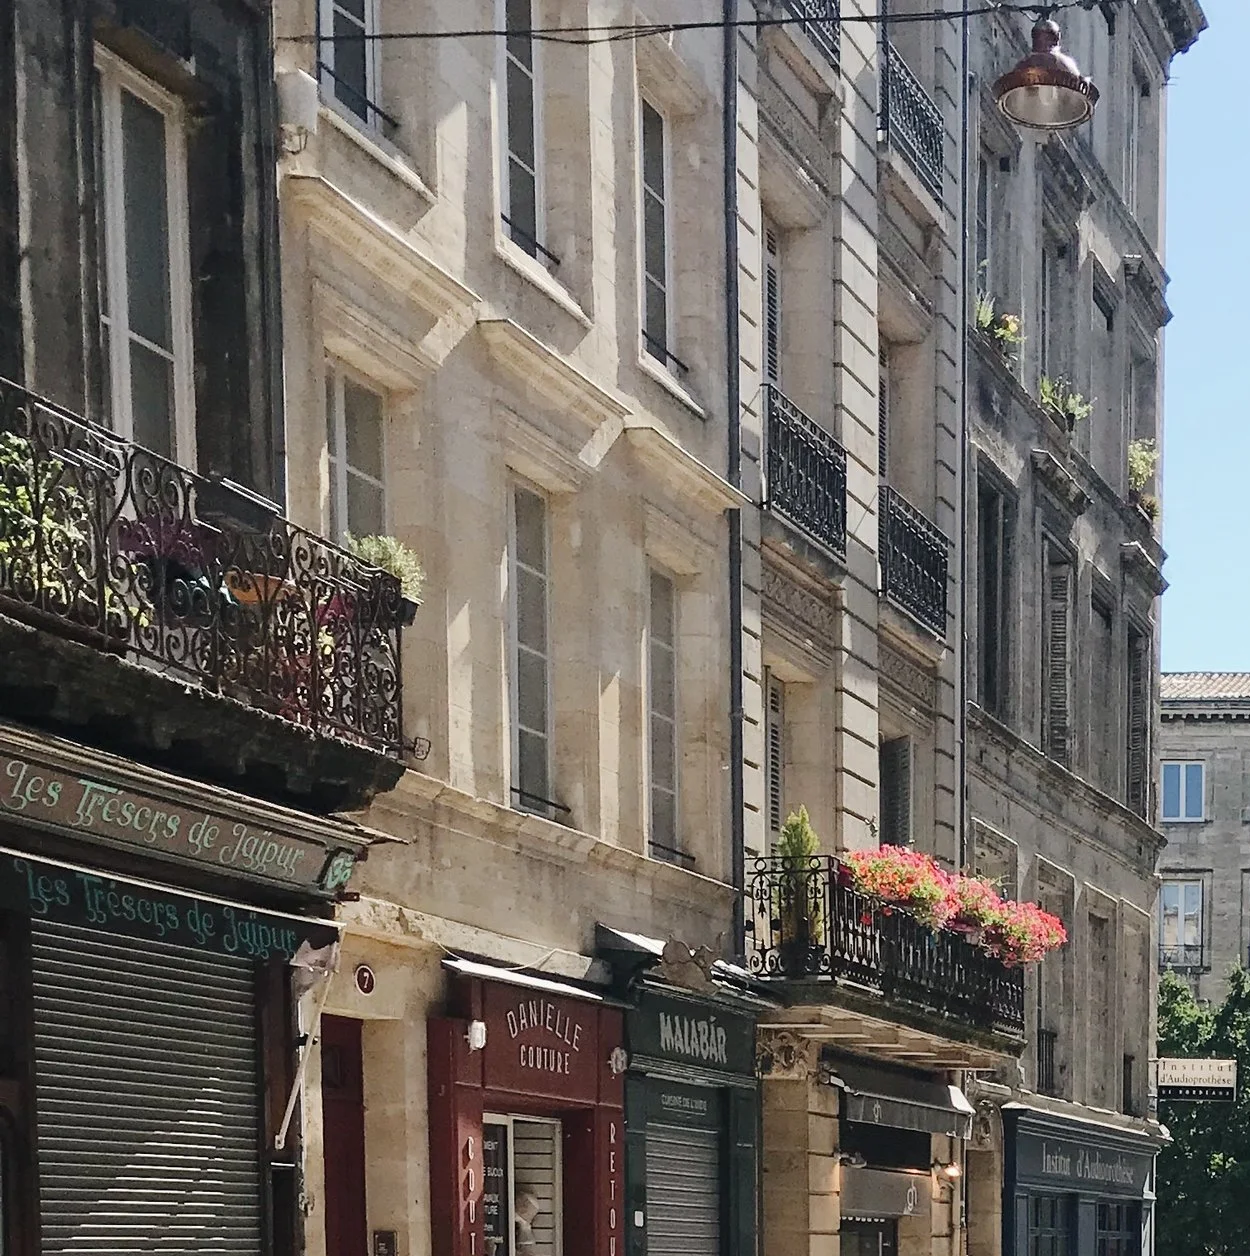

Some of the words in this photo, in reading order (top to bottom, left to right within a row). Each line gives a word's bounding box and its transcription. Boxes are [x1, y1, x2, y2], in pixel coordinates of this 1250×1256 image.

[2, 760, 63, 810] Les
[67, 779, 181, 842] Trésors
[188, 814, 219, 855] de
[220, 822, 305, 877] Jaïpur
[14, 859, 70, 914] Les
[77, 875, 180, 936] Trésors
[187, 901, 217, 945] de
[363, 971, 370, 989] 7
[506, 999, 583, 1053] DANIELLE
[520, 1044, 570, 1075] COUTURE
[1161, 1061, 1232, 1072] Institut
[1160, 1073, 1232, 1085] d'Audioprothèse
